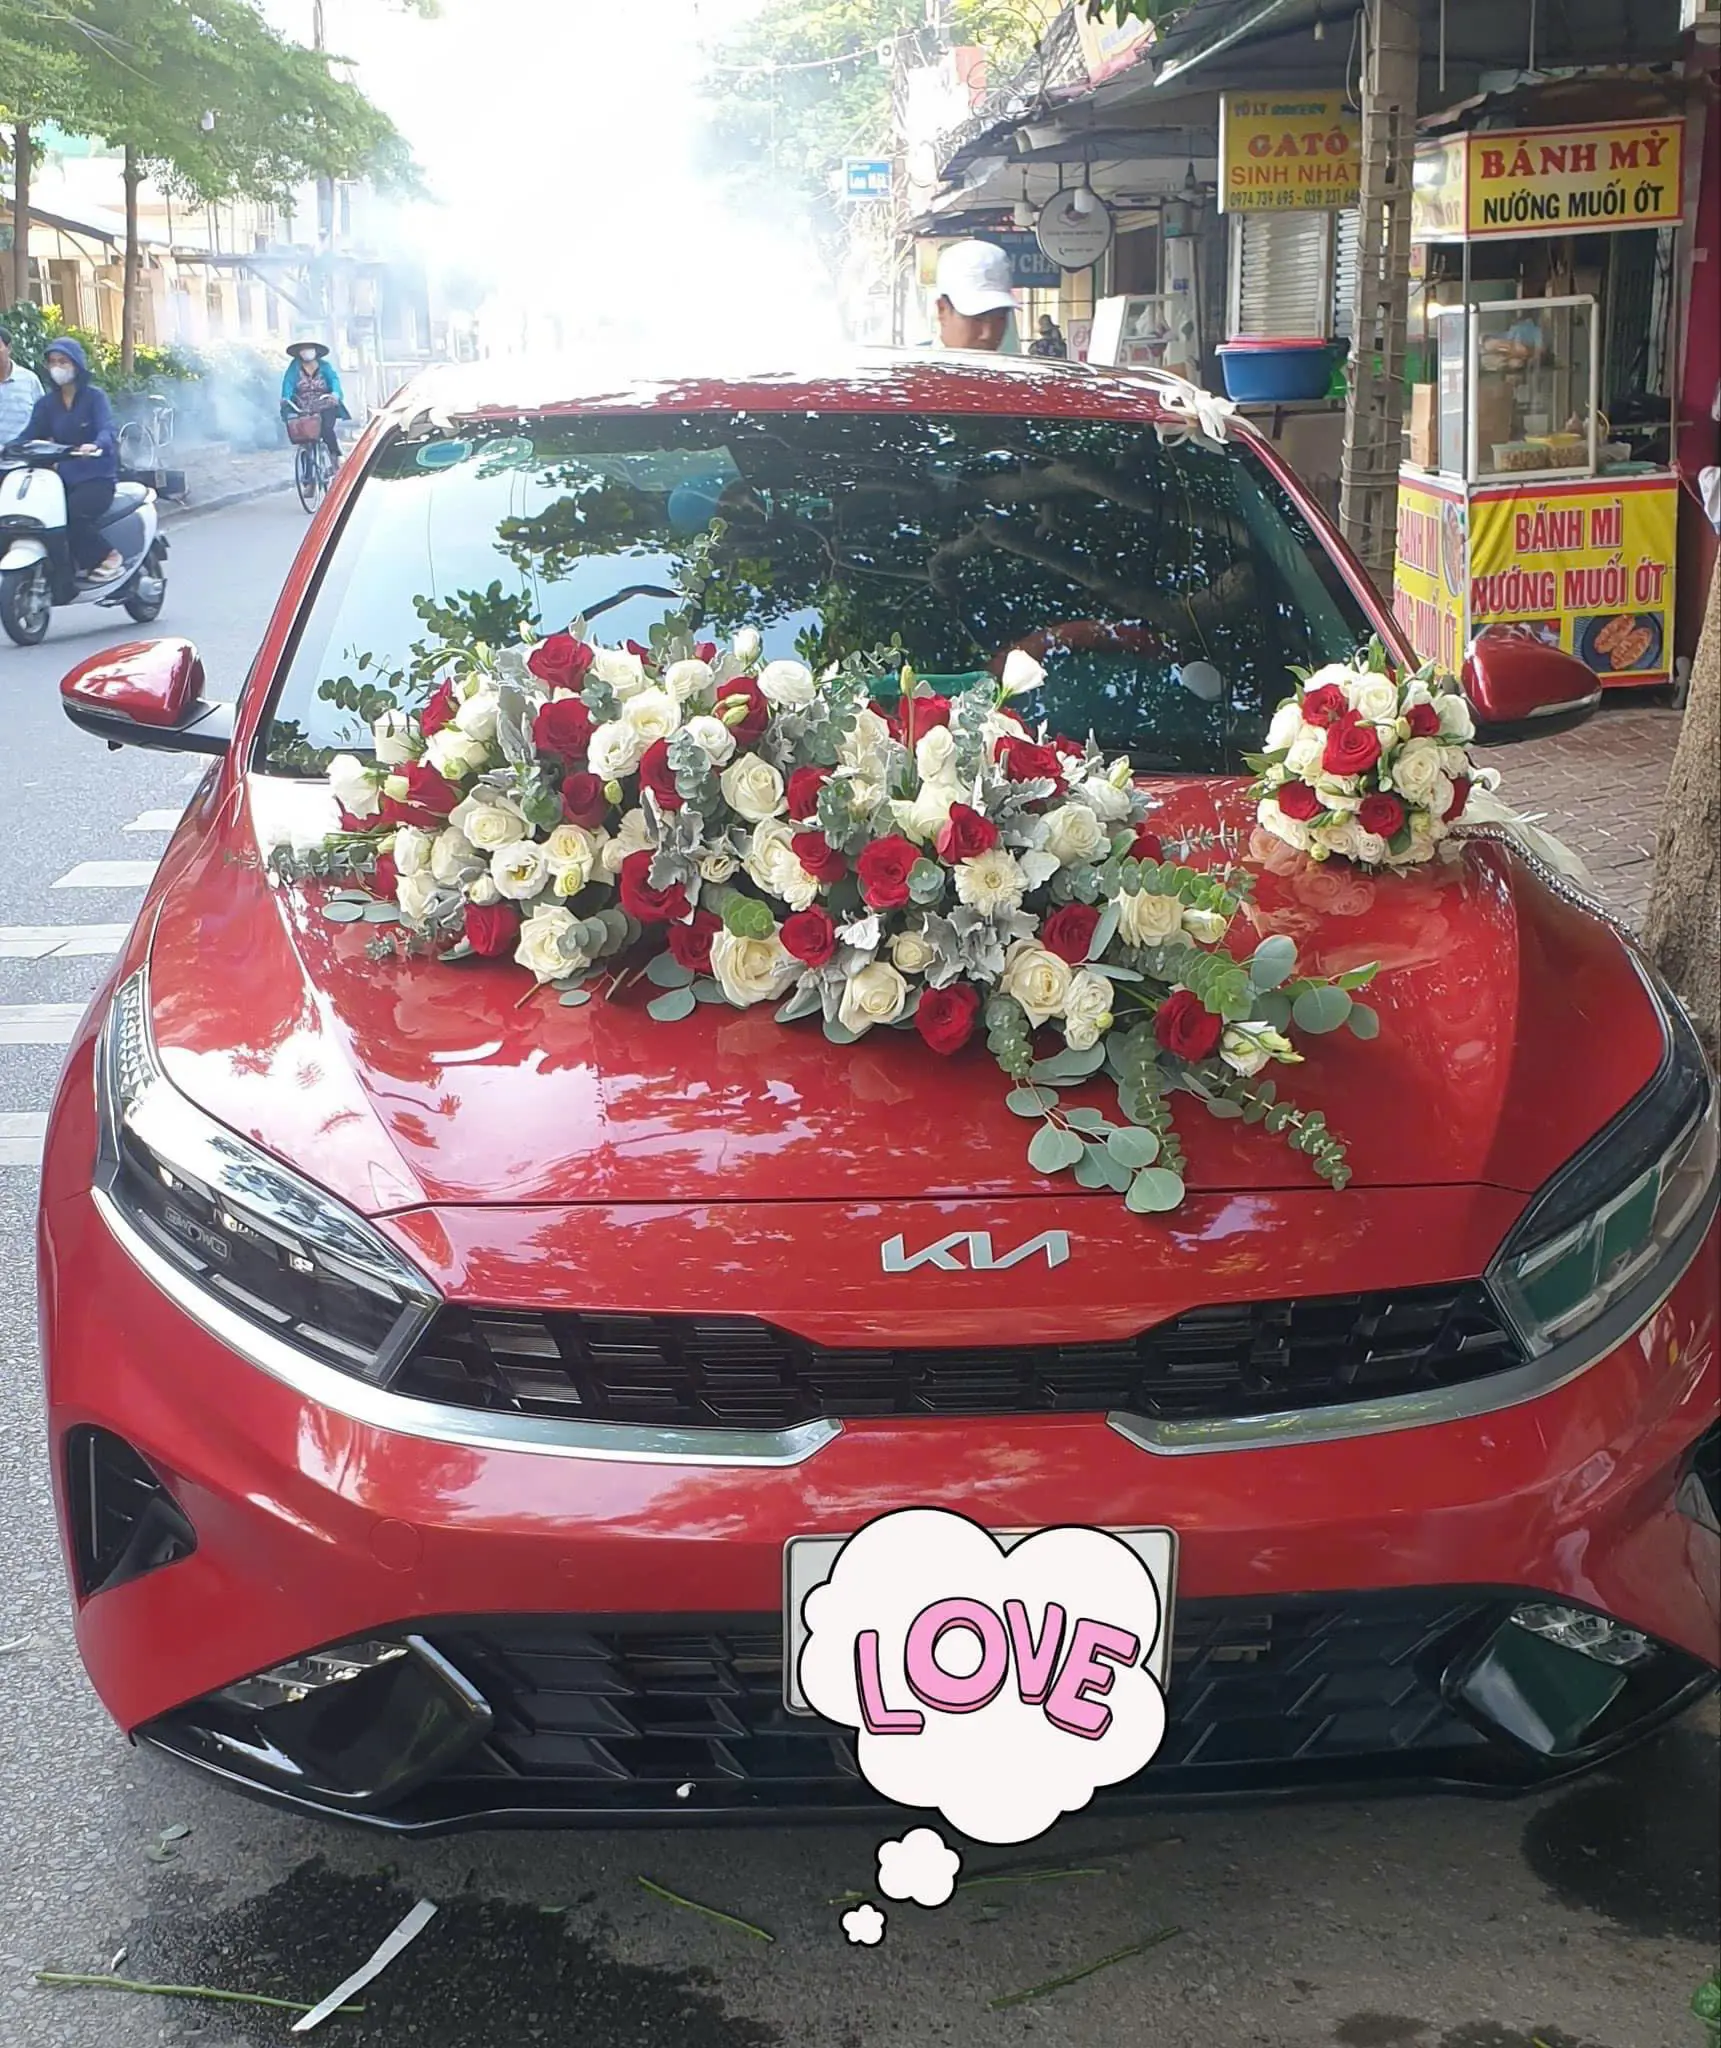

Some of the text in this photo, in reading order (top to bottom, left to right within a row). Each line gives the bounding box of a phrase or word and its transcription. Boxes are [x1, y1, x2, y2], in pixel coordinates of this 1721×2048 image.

[1248, 124, 1349, 157] GATÔ
[1481, 139, 1598, 179] BÁNH
[1231, 165, 1289, 185] SINH
[1484, 188, 1560, 224] NƯỚNG
[1568, 179, 1625, 218] MUỐI
[1634, 180, 1664, 213] ỚT
[1515, 498, 1623, 554] BÁNH MÌ
[1471, 552, 1667, 616] NƯỚNG MUỐI ỚT
[881, 1230, 1070, 1272] KIA
